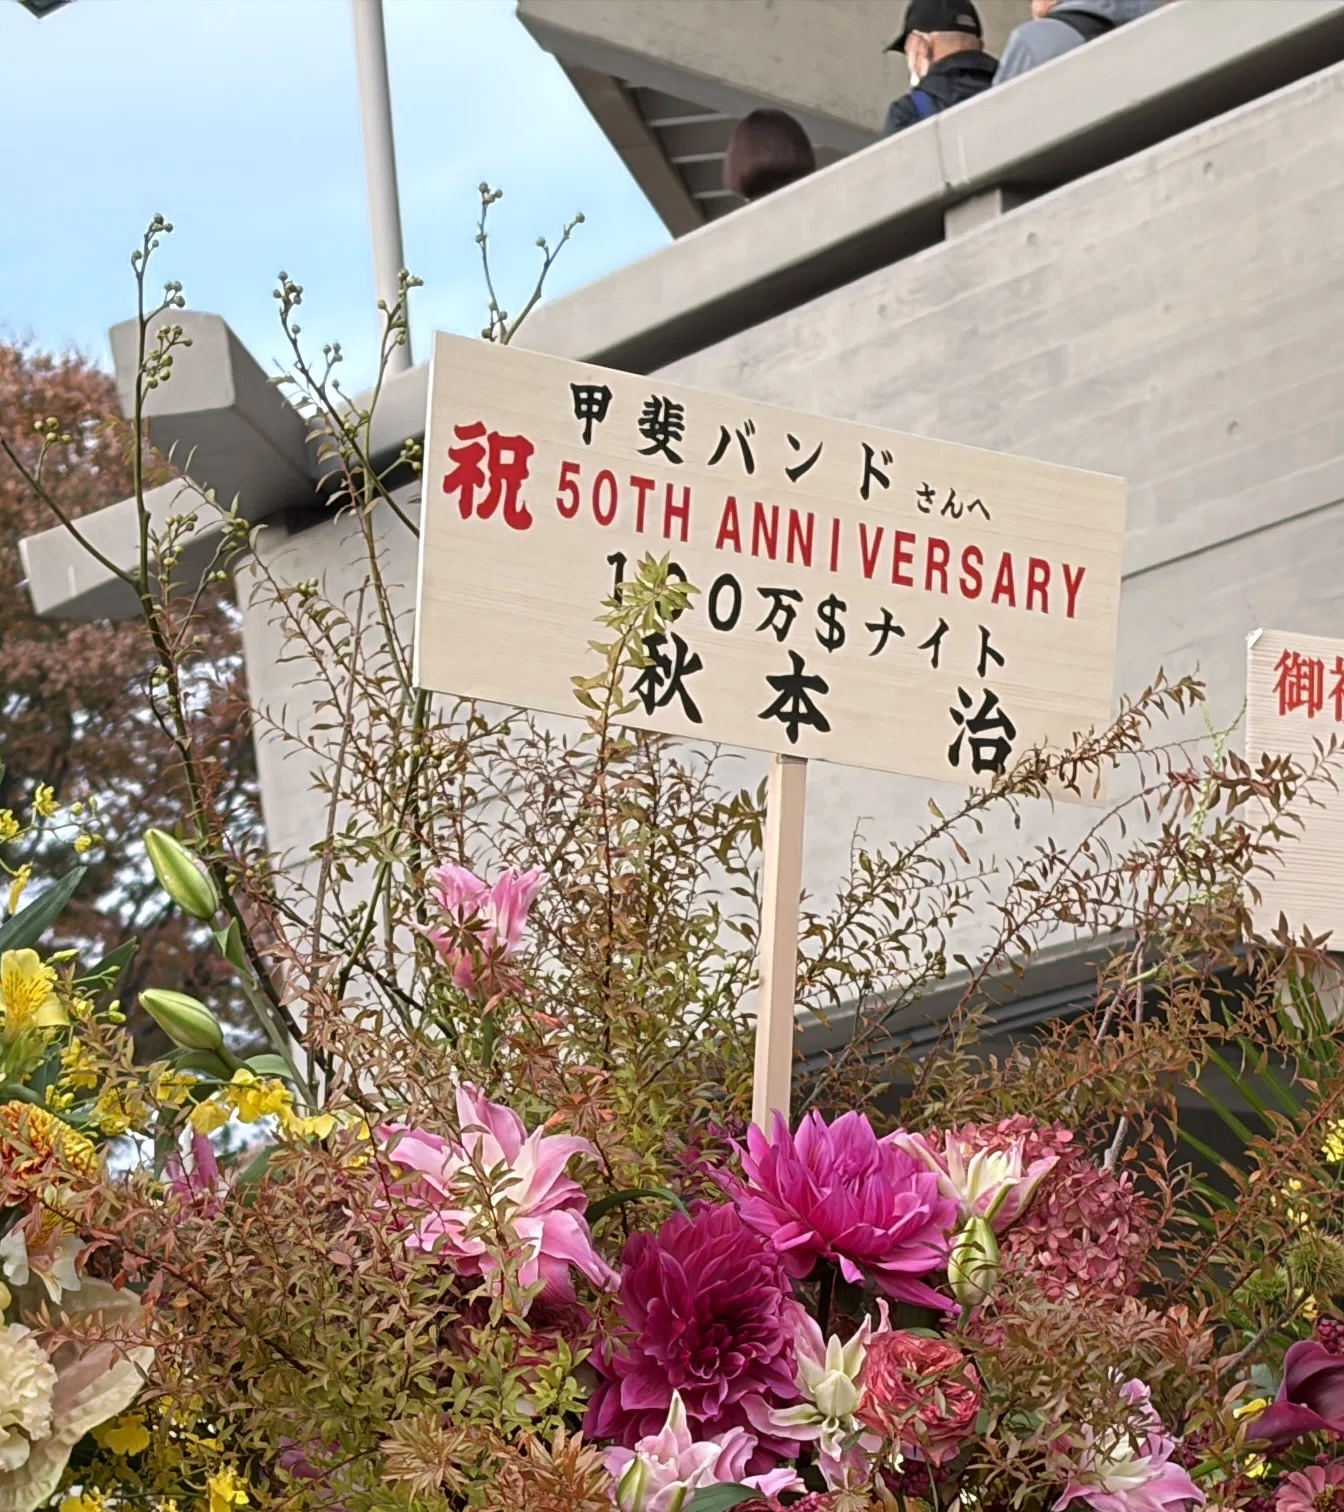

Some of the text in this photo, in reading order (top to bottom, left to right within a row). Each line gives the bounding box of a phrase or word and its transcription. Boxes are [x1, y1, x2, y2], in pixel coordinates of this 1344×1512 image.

[443, 422, 1086, 618] 祝 50TH ANNIVERSARY
